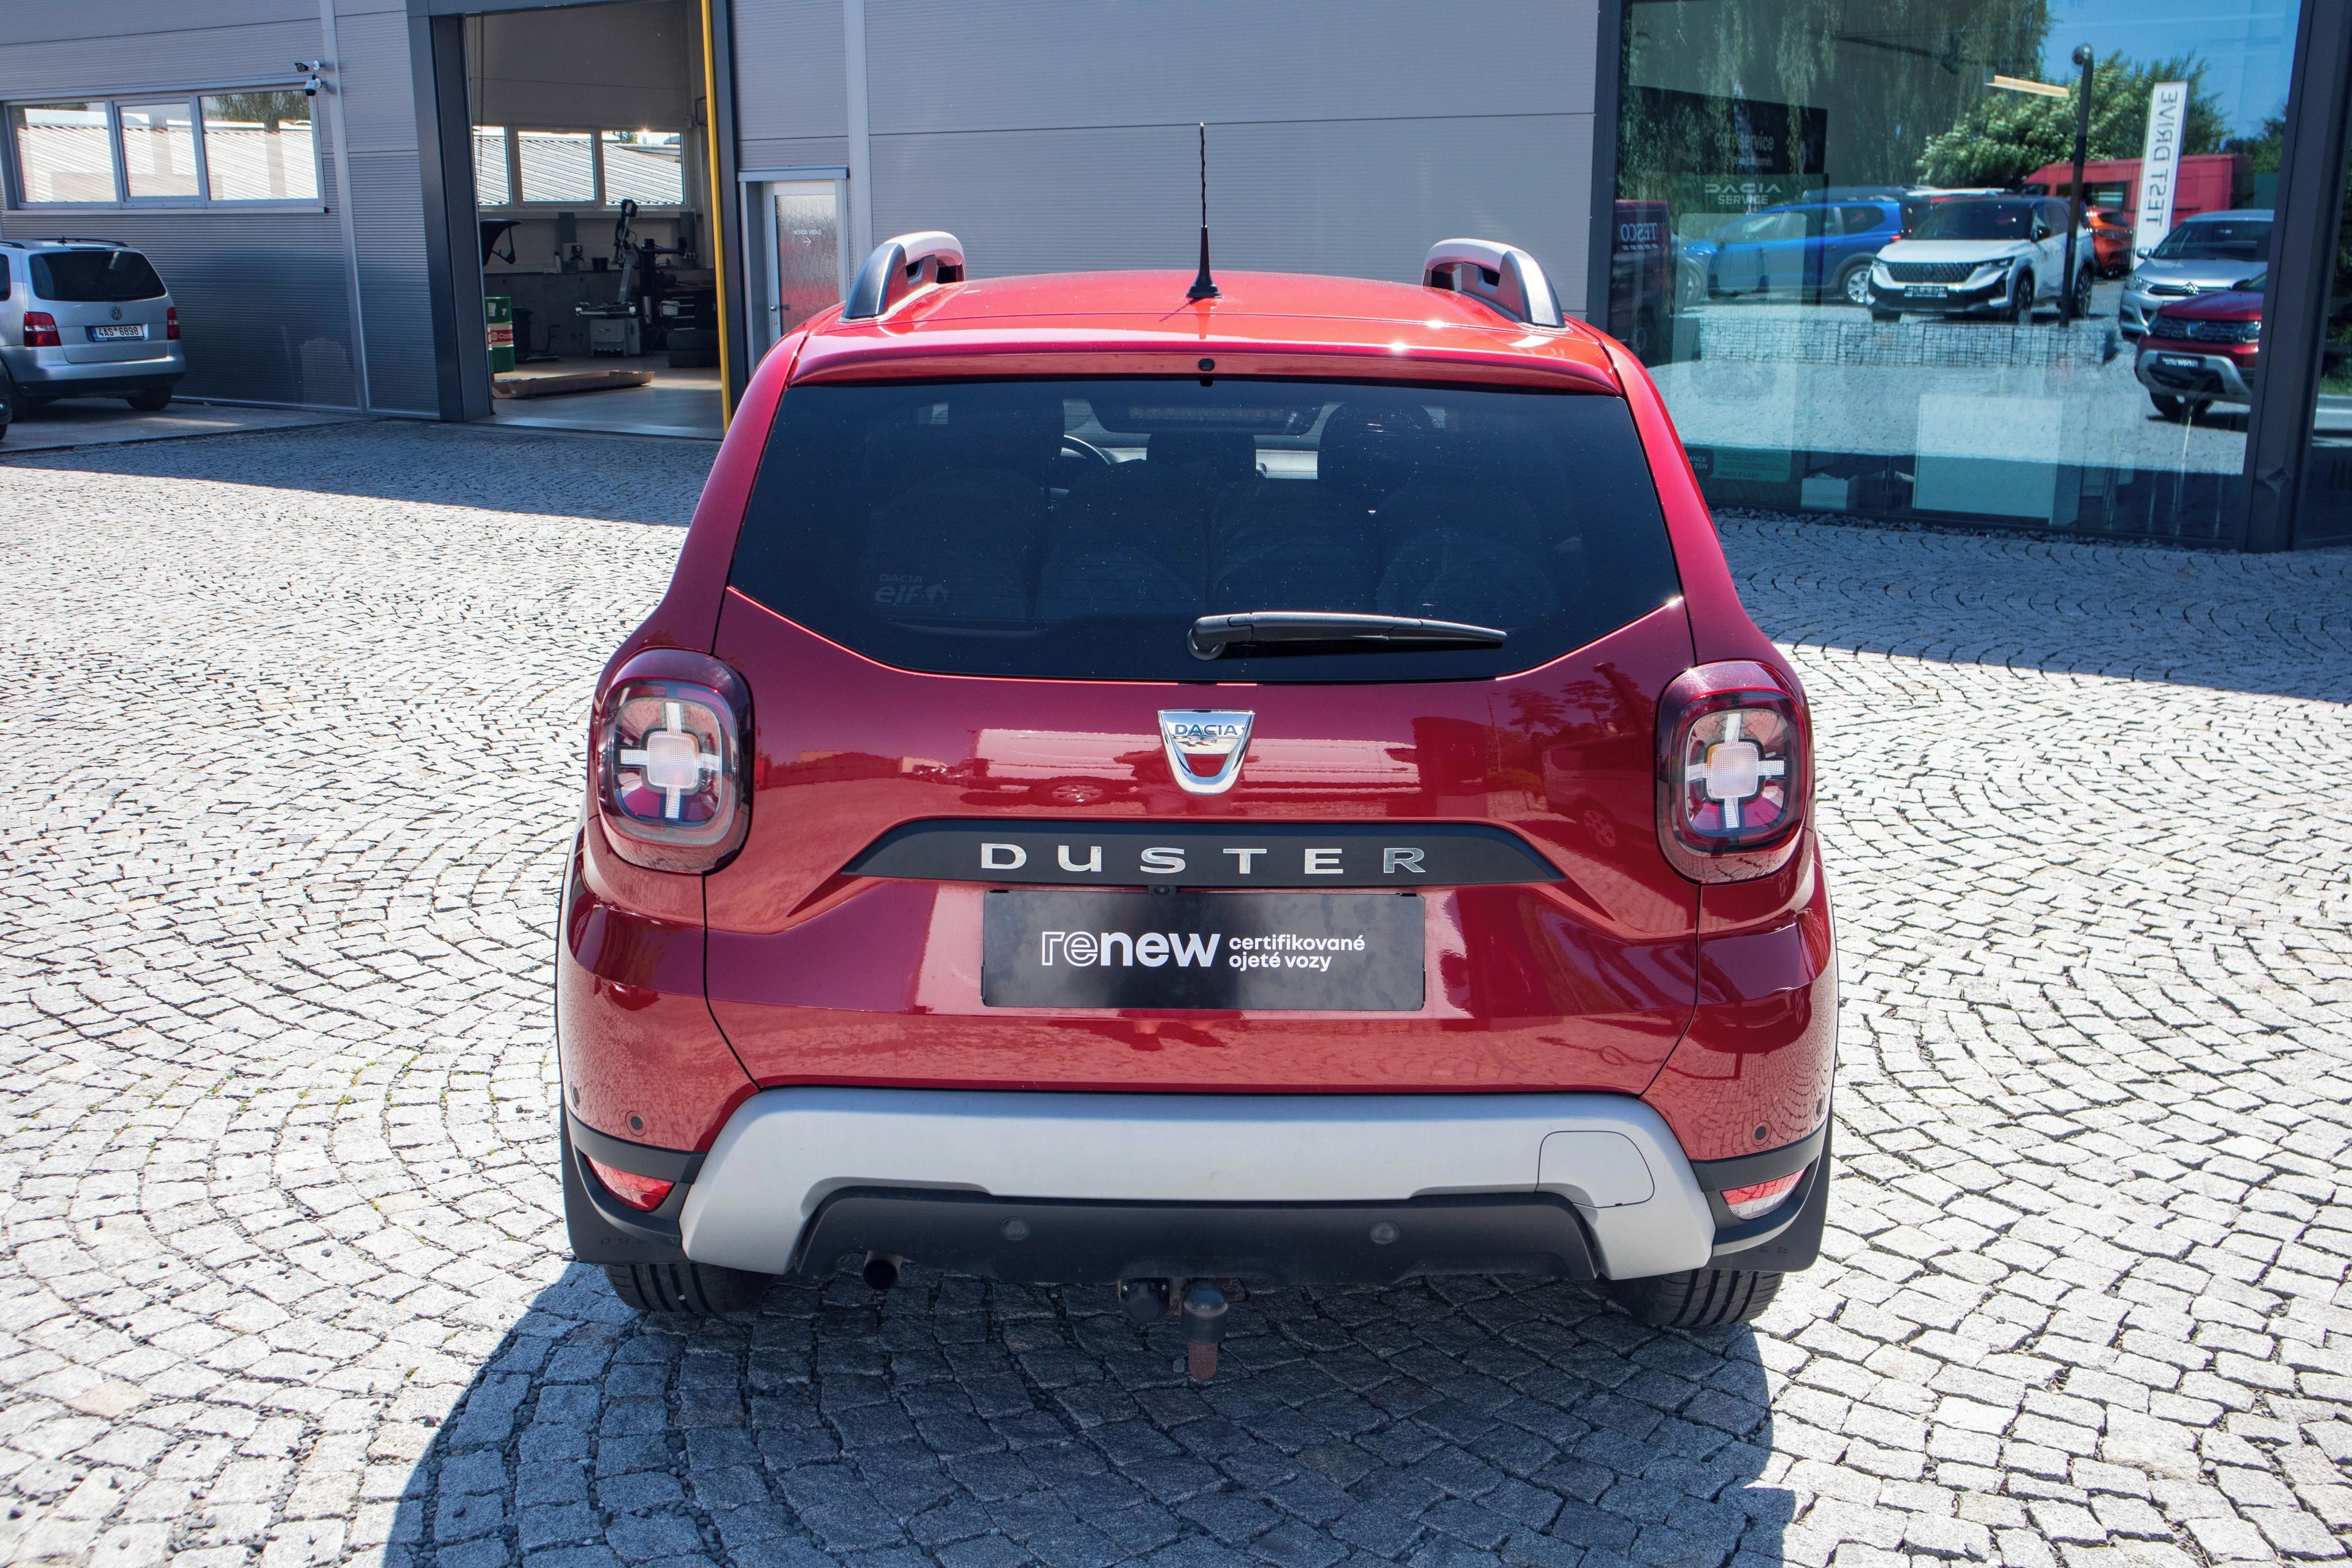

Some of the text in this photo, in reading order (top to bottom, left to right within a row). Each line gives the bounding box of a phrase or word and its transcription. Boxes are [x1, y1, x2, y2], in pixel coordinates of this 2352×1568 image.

[1739, 130, 1774, 151] service
[1705, 183, 1782, 193] DACIA
[1717, 195, 1769, 205] SERVICE
[99, 326, 139, 337] 4AS 6898
[879, 574, 923, 583] DACIA
[874, 584, 923, 604] elf
[1175, 724, 1238, 735] DACIA
[981, 842, 1427, 875] DUSTER
[1042, 931, 1221, 967] renew
[1229, 934, 1365, 951] certifikované
[1229, 951, 1332, 972] ojeté vozy
